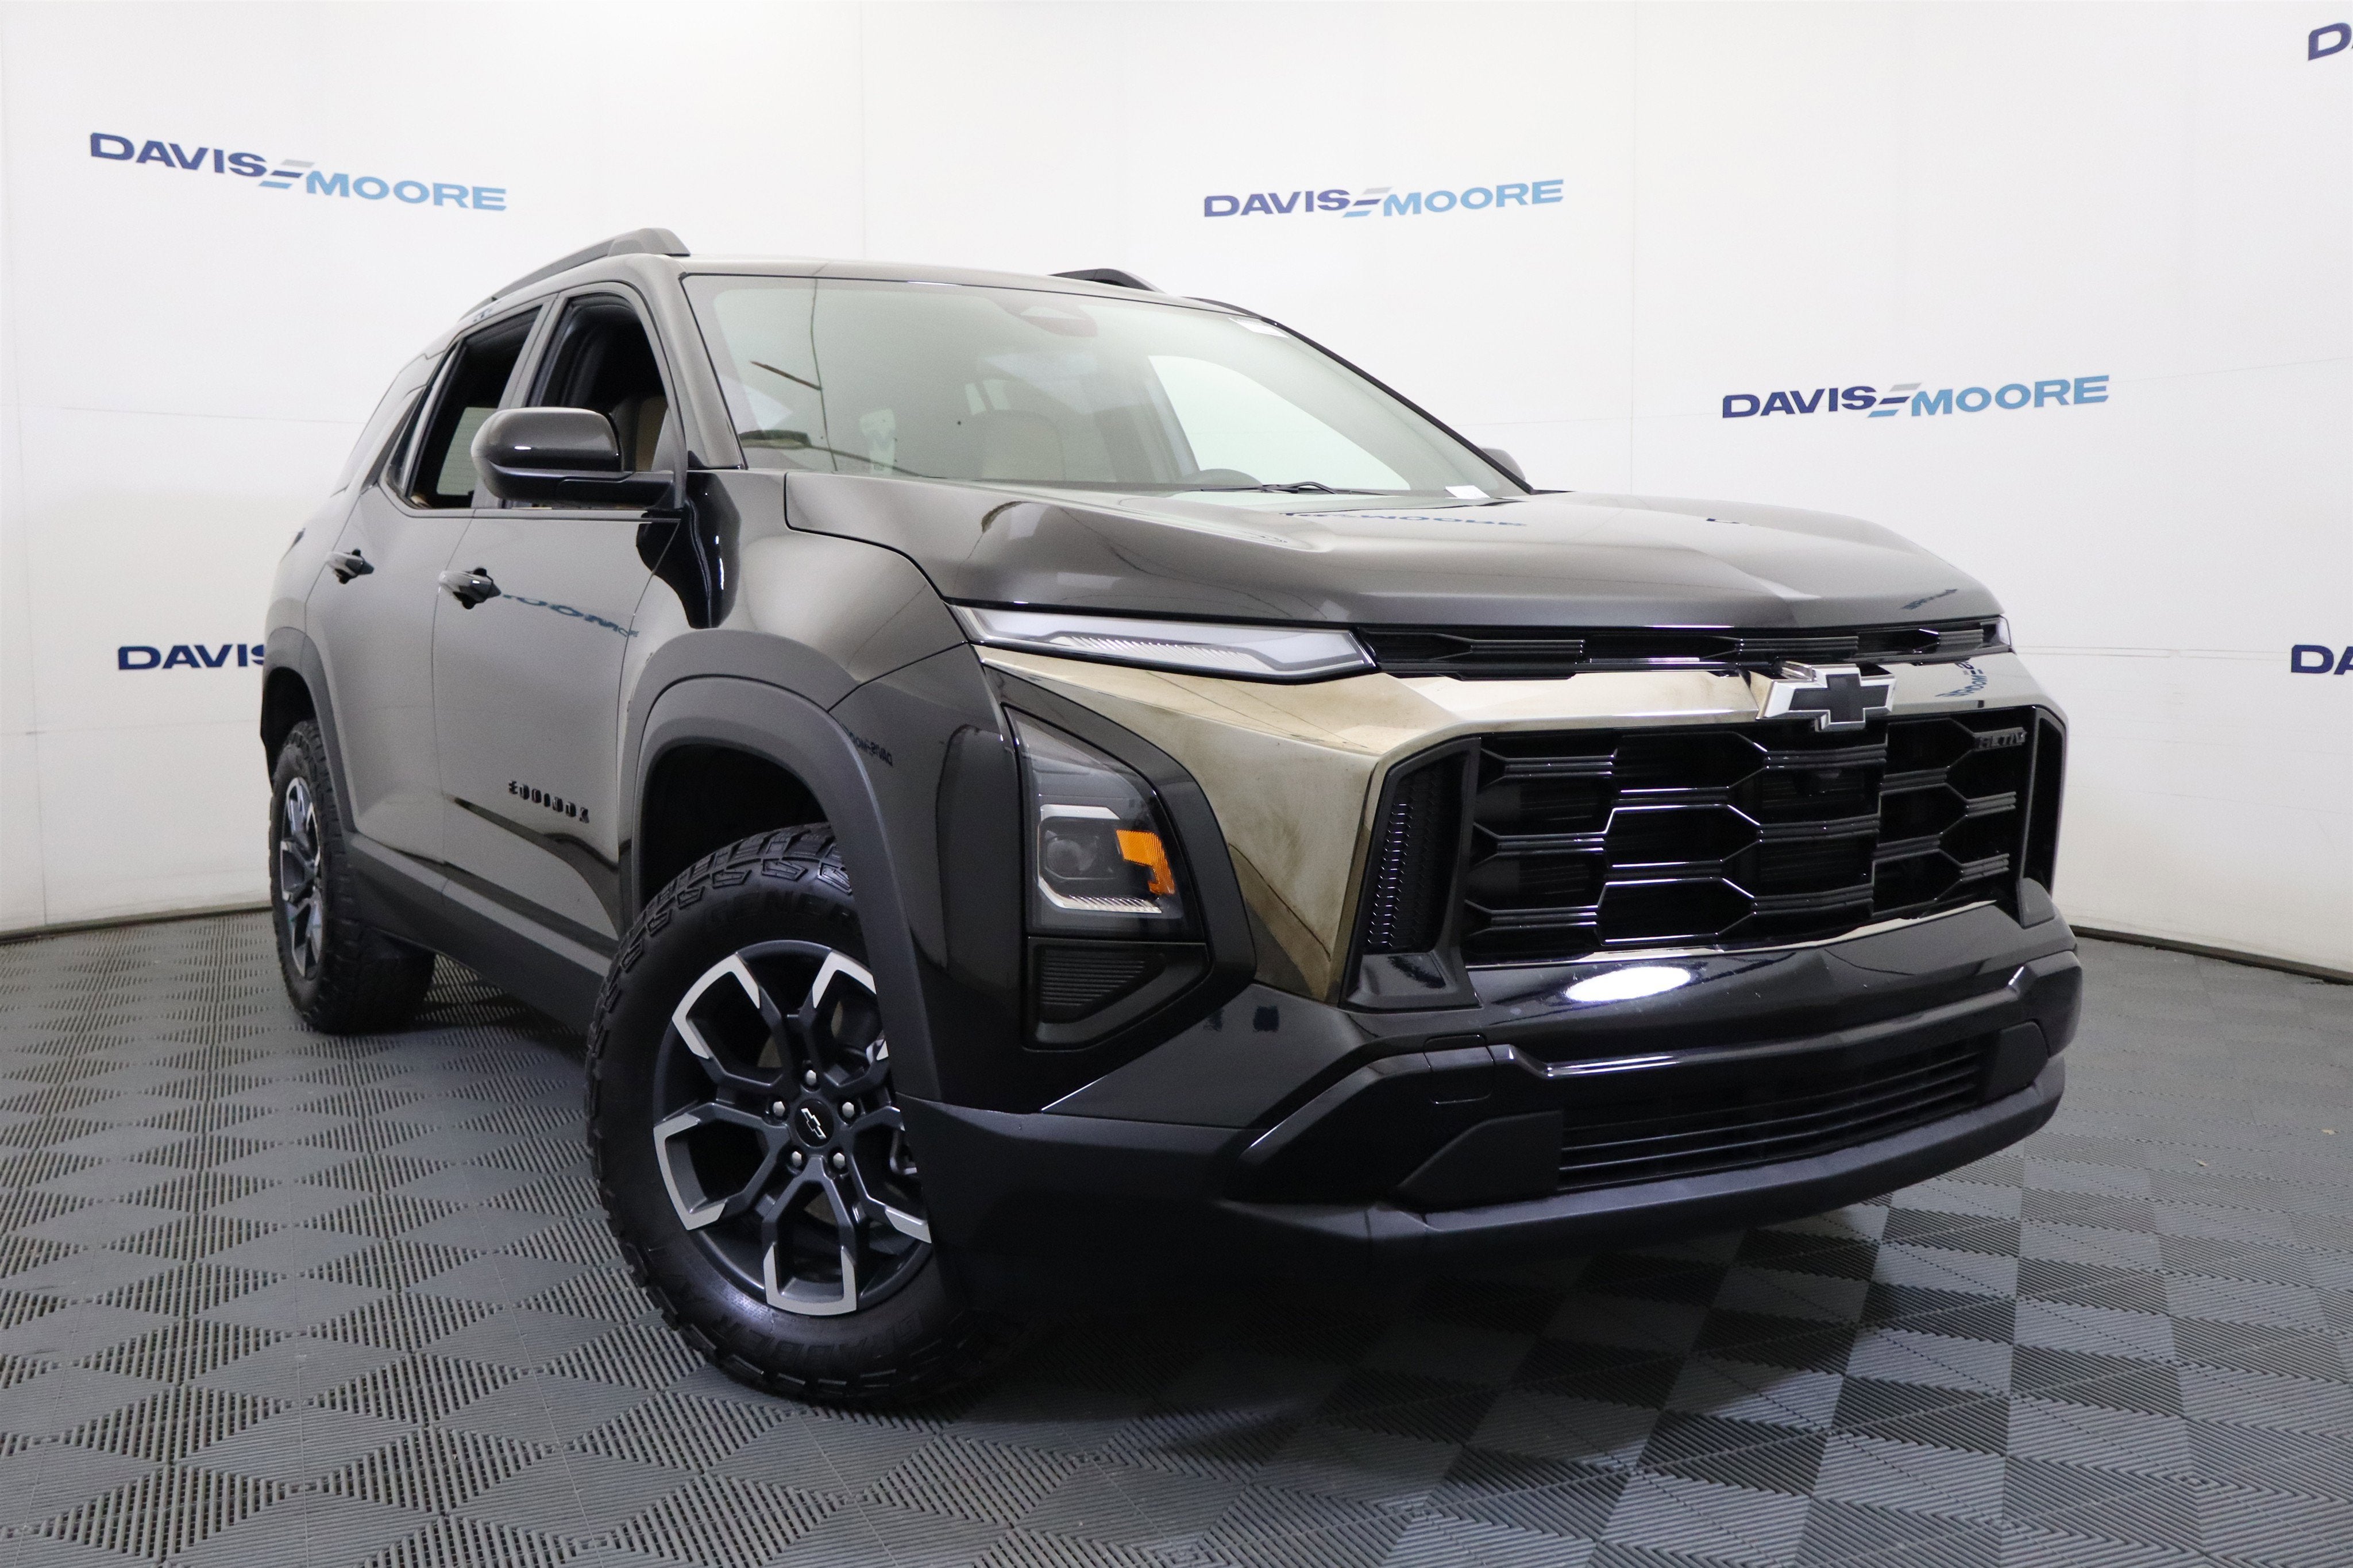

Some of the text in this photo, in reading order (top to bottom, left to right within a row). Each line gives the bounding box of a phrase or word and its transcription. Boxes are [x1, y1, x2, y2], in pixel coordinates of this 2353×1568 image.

[2308, 22, 2353, 61] D
[90, 132, 507, 211] DAVIS MOORE
[1204, 179, 1564, 218] DAVIS MOORE
[1722, 374, 2109, 419] DAVIS MOORE
